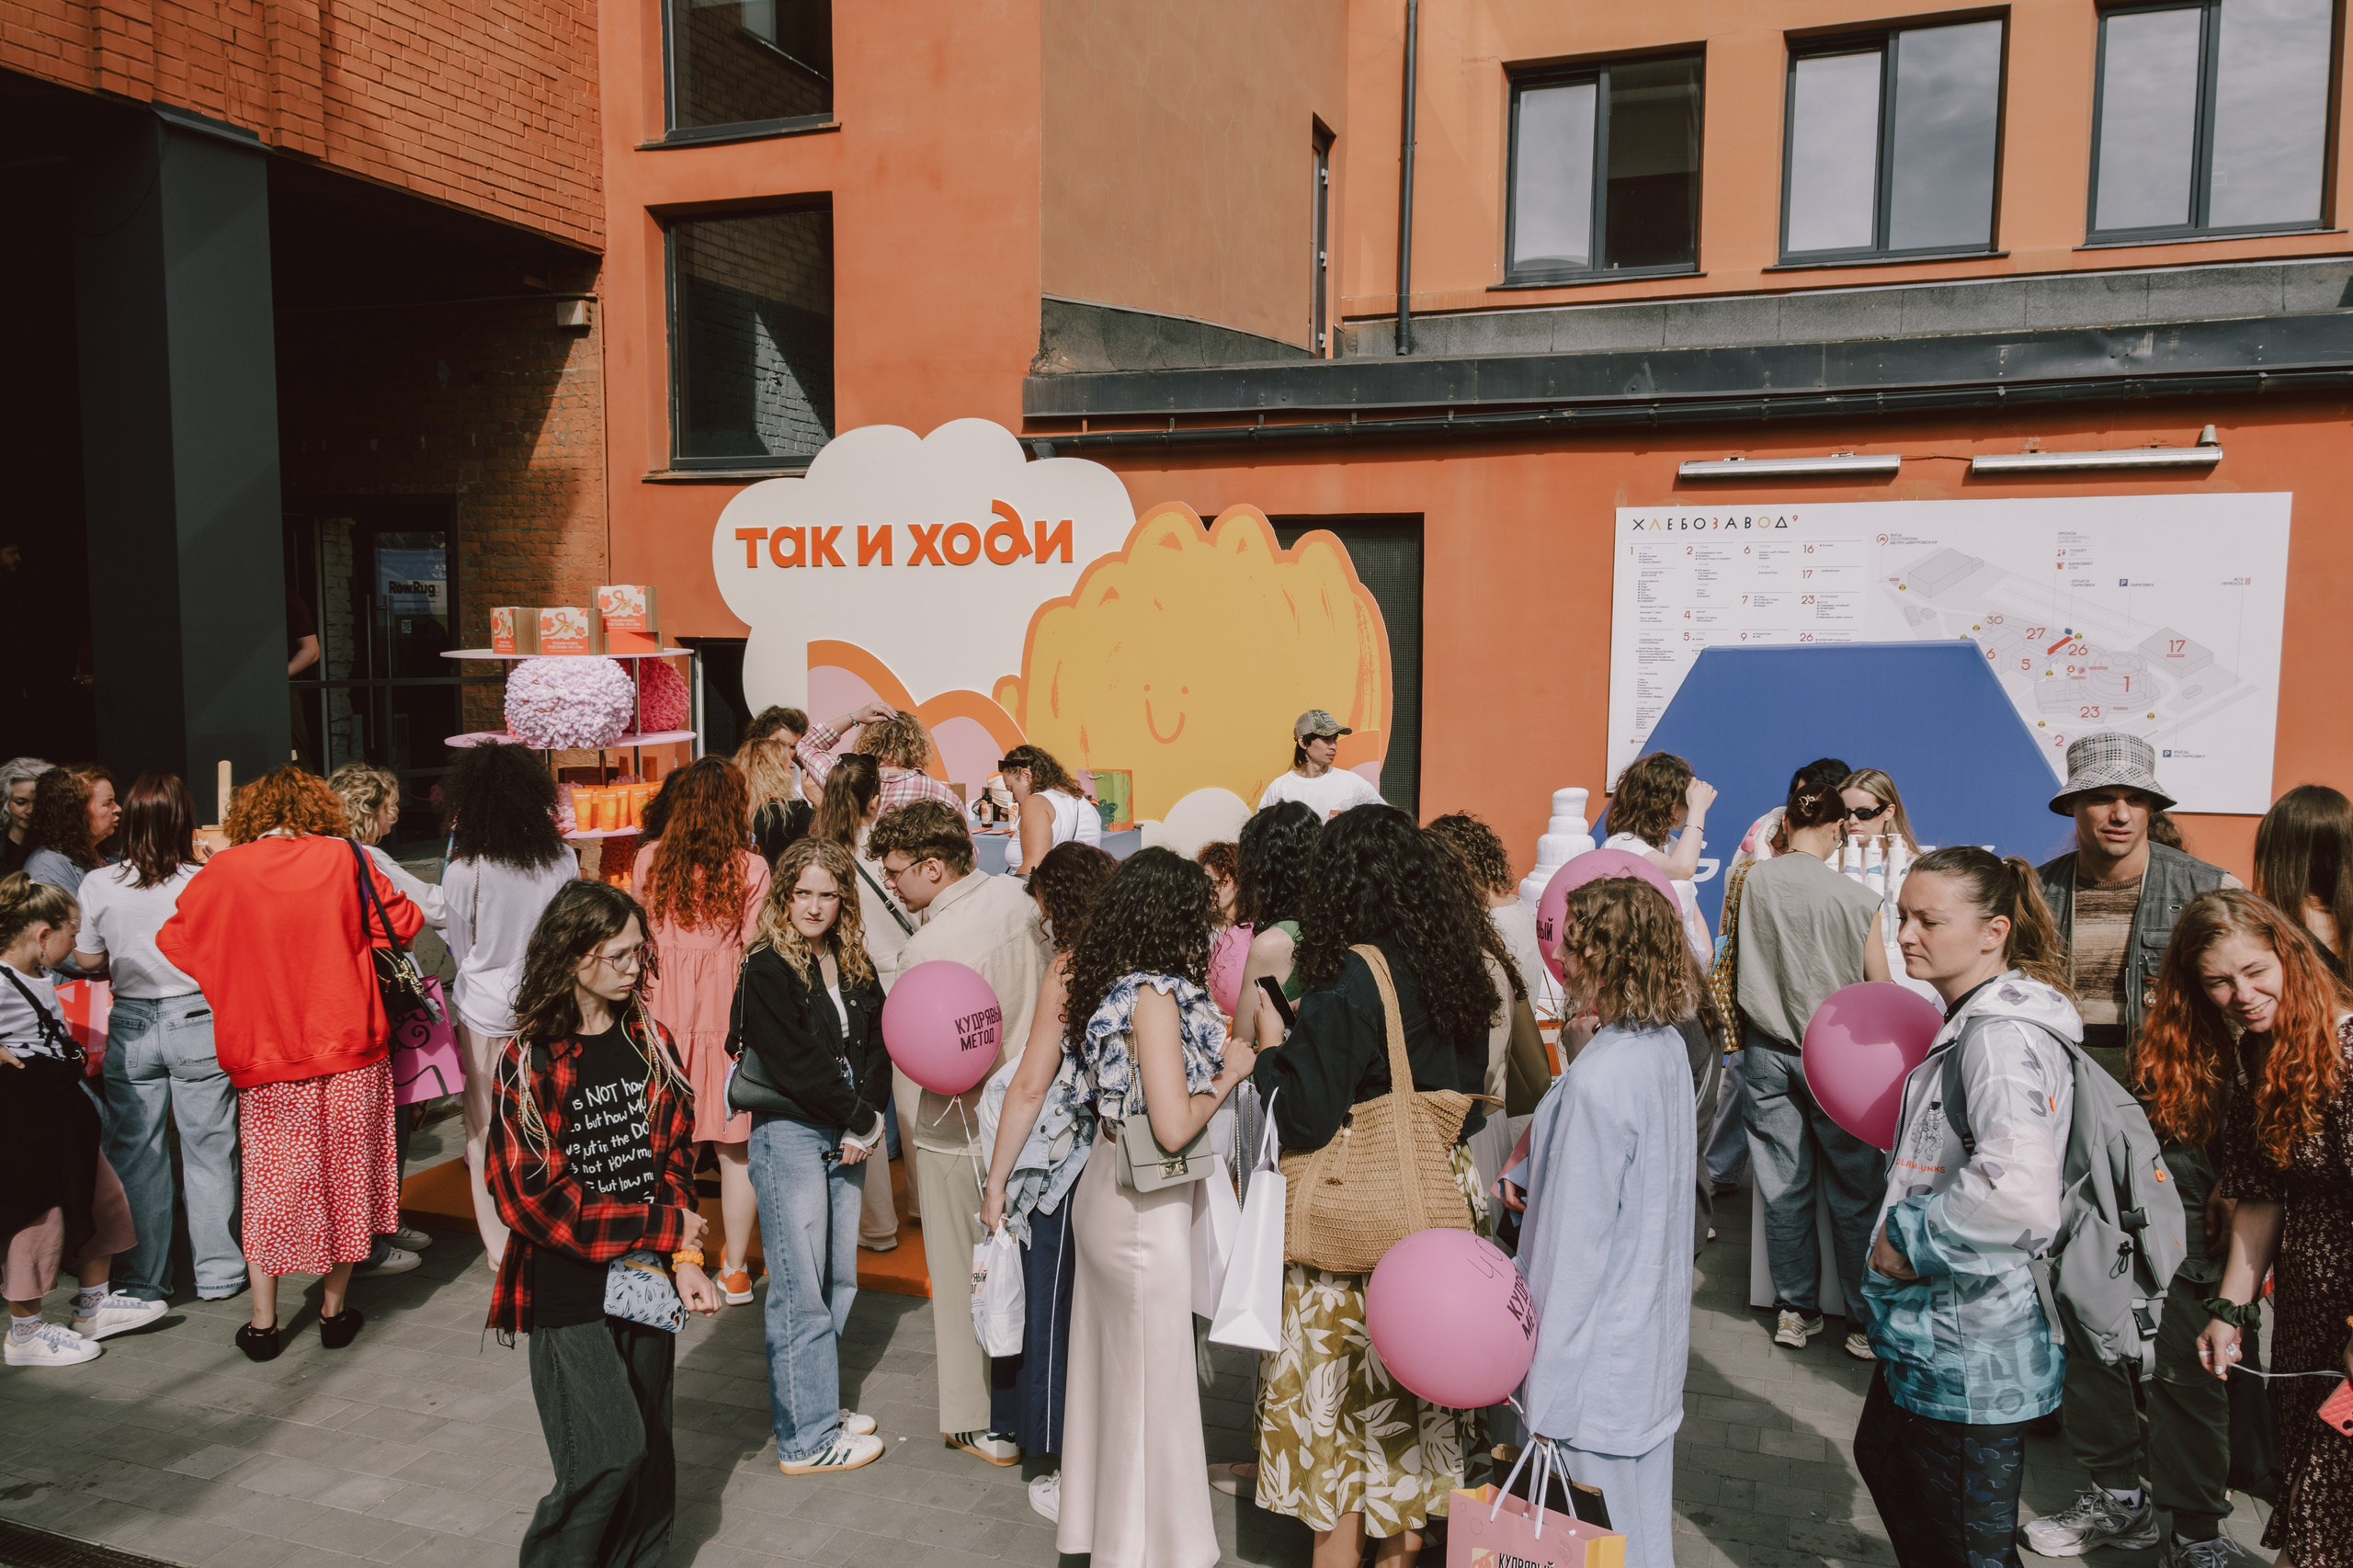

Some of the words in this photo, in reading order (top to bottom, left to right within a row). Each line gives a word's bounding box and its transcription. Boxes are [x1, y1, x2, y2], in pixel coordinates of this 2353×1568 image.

[734, 526, 847, 568] так
[857, 524, 893, 567] и
[907, 499, 1074, 567] ходи
[1686, 546, 1693, 555] 2
[1744, 545, 1751, 555] 6
[1802, 544, 1814, 554] 16
[1802, 569, 1813, 579] 17
[388, 581, 436, 597] RowRug
[1742, 596, 1749, 605] 7
[1801, 595, 1815, 605] 23
[1684, 610, 1691, 619] 4
[1986, 616, 2004, 625] 30
[1683, 631, 1690, 642] 5
[1740, 632, 1747, 642] 9
[1799, 632, 1813, 642] 26
[2026, 627, 2046, 640] 27
[2067, 643, 2088, 656] 26
[2169, 640, 2186, 653] 17
[1985, 647, 1995, 660] 6
[2020, 658, 2031, 671] 5
[2123, 676, 2131, 693] 1
[2079, 706, 2100, 718] 23
[2053, 734, 2064, 747] 2
[960, 1028, 995, 1051] МЕТОД
[585, 1082, 619, 1108] NOT
[585, 1114, 602, 1131] but
[603, 1110, 628, 1126] how
[610, 1134, 630, 1148] the
[583, 1161, 603, 1174] not
[597, 1179, 618, 1194] but
